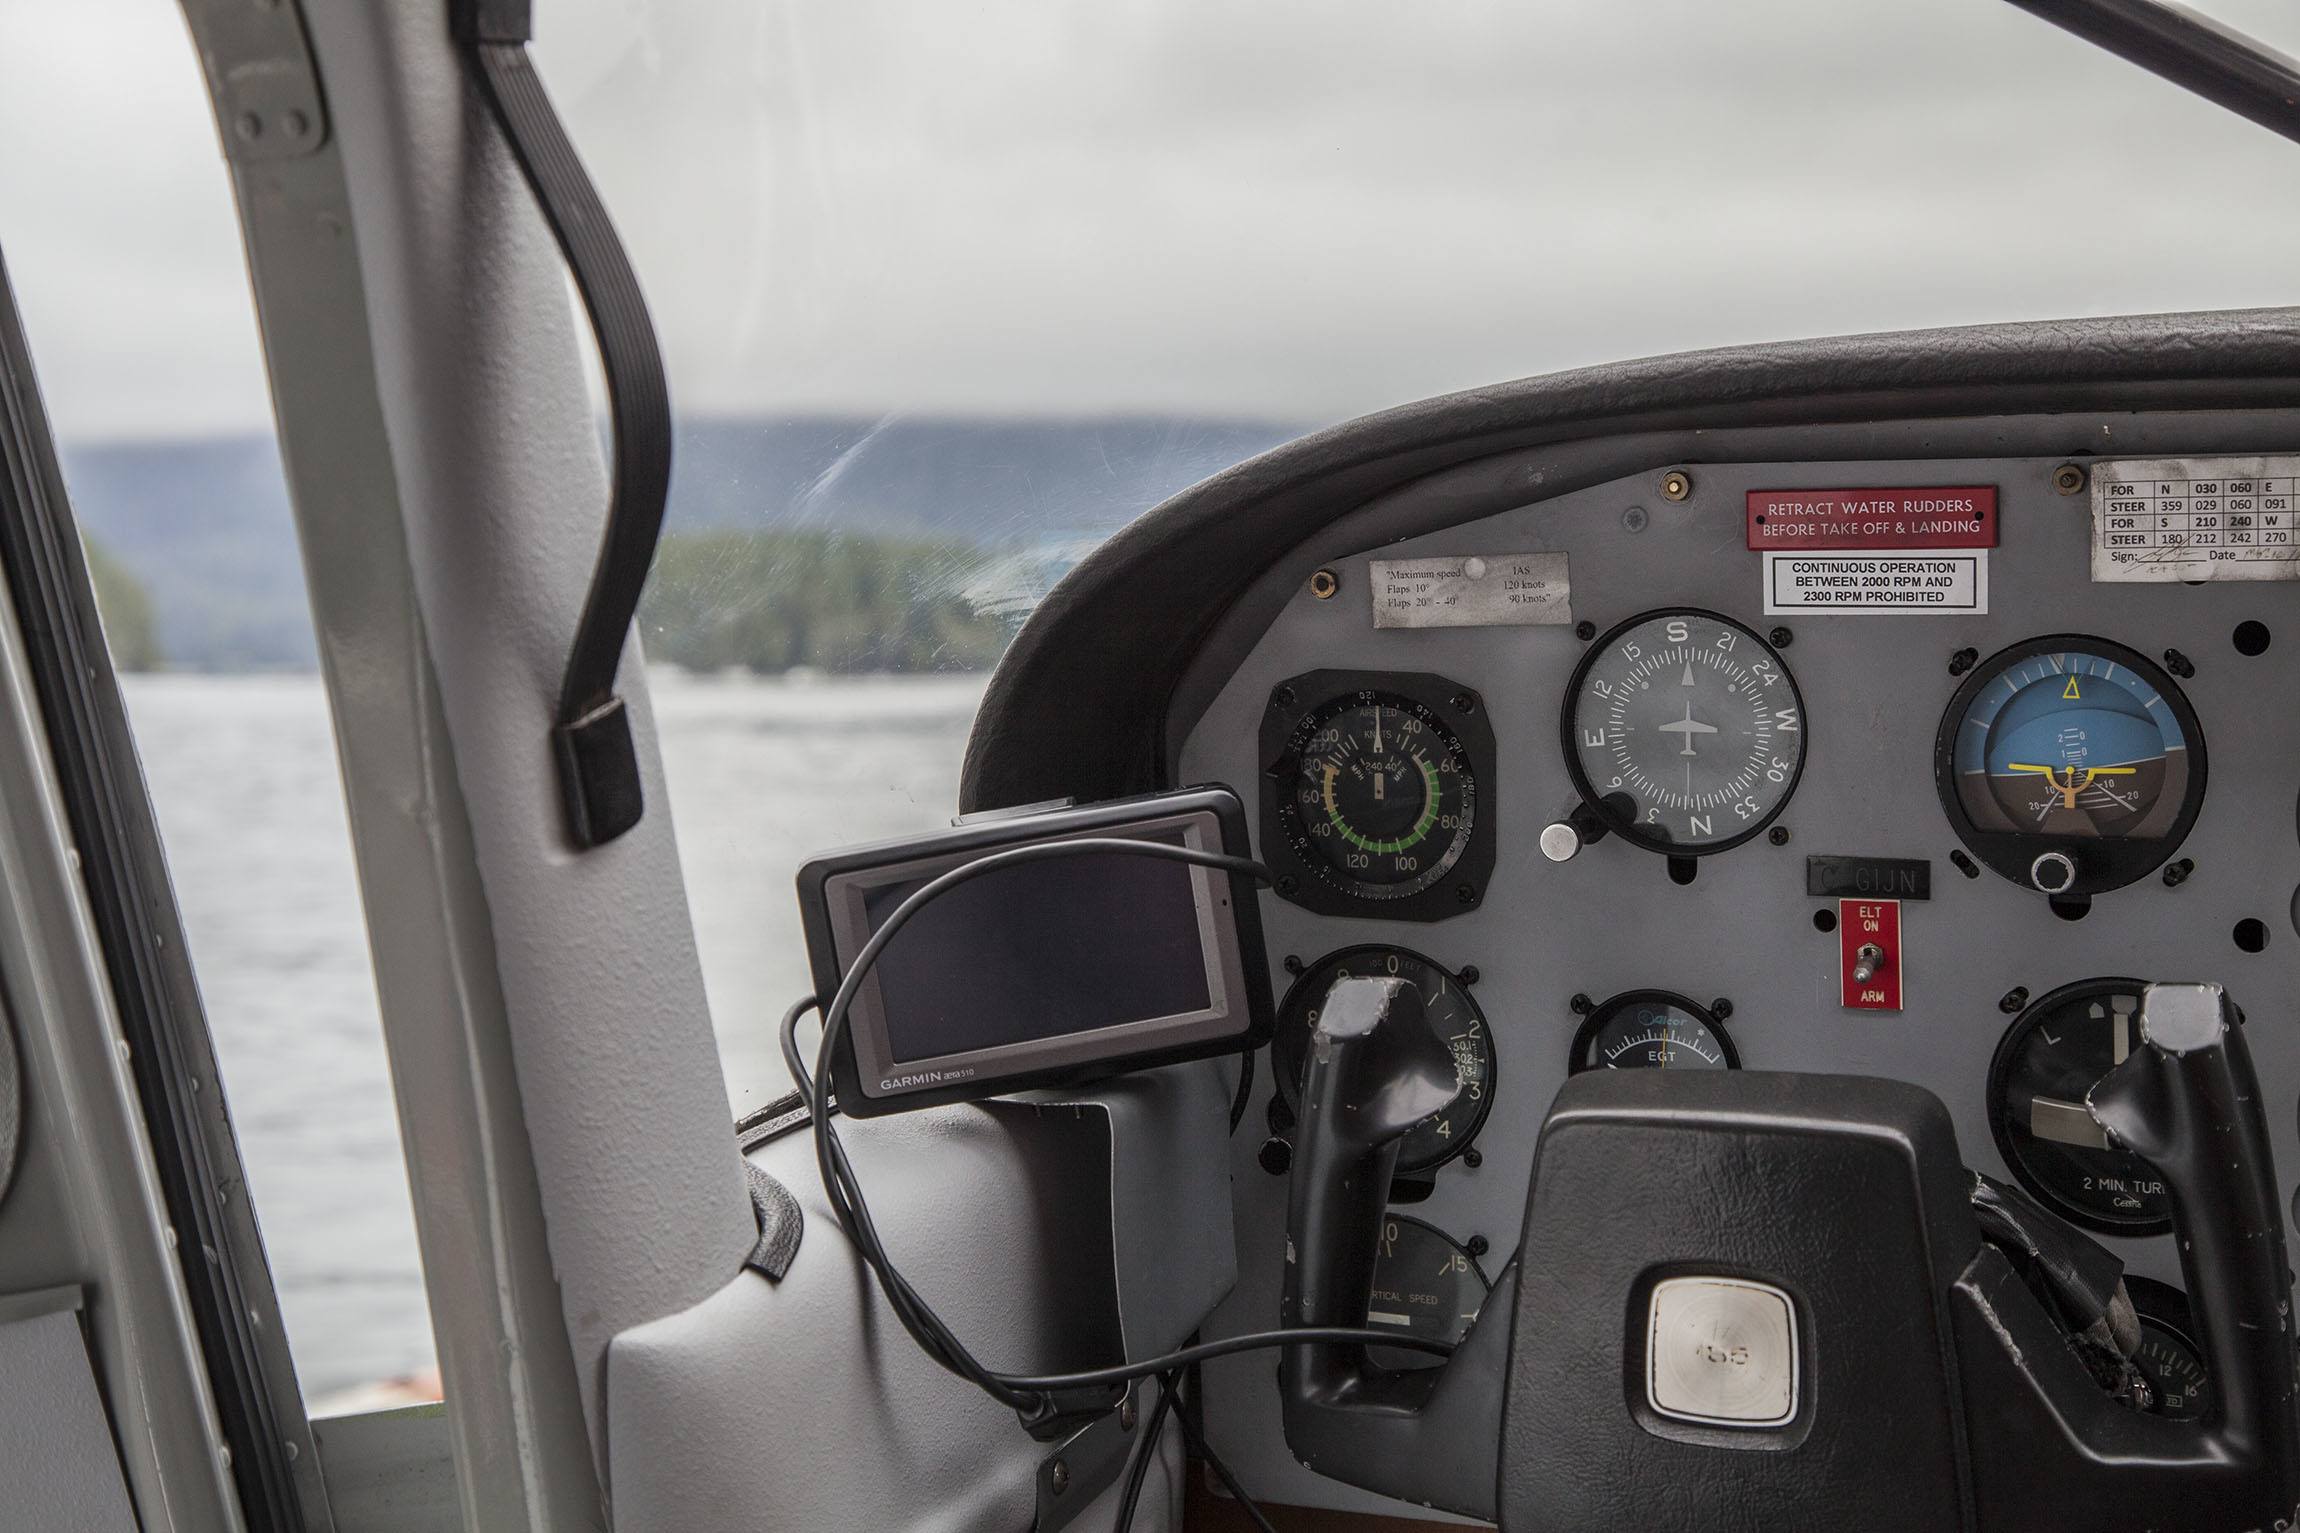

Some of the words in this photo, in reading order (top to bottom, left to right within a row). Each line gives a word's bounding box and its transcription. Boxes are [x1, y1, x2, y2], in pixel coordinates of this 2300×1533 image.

[2111, 485, 2134, 495] FOR
[2161, 484, 2170, 494] N
[2195, 483, 2217, 494] 030
[2230, 482, 2252, 492] 060
[2265, 482, 2272, 492] E
[1768, 503, 1834, 515] RETRACT
[1841, 501, 1897, 514] WATER
[1903, 499, 1973, 513] RUDDERS
[2111, 502, 2145, 512] STEER
[2161, 501, 2183, 511] 359
[2195, 500, 2217, 511] 029
[2230, 499, 2252, 510] 060
[2265, 498, 2287, 509] 091
[1763, 523, 1815, 536] BEFORE
[1820, 523, 1858, 535] TAKE
[1863, 522, 1890, 535] OFF
[1895, 522, 1905, 534] &
[1911, 520, 1981, 534] LANDING
[2111, 518, 2134, 528] FOR
[2161, 518, 2168, 528] S
[2195, 516, 2217, 527] 210
[2230, 516, 2252, 526] 240
[2265, 516, 2278, 526] W
[2111, 535, 2145, 545] STEER
[2161, 534, 2183, 545] 180
[2195, 533, 2217, 544] 212
[2230, 532, 2252, 543] 242
[2265, 532, 2287, 543] 270
[2111, 550, 2138, 563] Sign:
[2209, 550, 2236, 561] Date
[1436, 568, 1462, 580] speed
[1512, 566, 1531, 576] IAS
[1792, 562, 1876, 573] CONTINUOUS
[1879, 562, 1956, 573] OPERATION
[1503, 581, 1520, 590] 120
[1521, 580, 1546, 590] knots
[1796, 576, 1858, 587] BETWEEN
[1862, 576, 1890, 587] 2000
[1893, 576, 1921, 587] RPM
[1925, 576, 1953, 587] AND
[1387, 585, 1411, 595] Flaps
[1804, 591, 1832, 602] 2300
[1835, 591, 1862, 602] RPM
[1866, 591, 1944, 602] PROHIBITED
[1387, 598, 1411, 609] Flaps
[1509, 595, 1521, 604] 90
[1666, 621, 1689, 643] S
[1716, 631, 1737, 652] 21
[1621, 641, 1642, 662] 15
[1752, 659, 1779, 687] 24
[1592, 679, 1613, 699] 12
[1402, 719, 1422, 734] 40
[1775, 707, 1799, 731] W
[1584, 727, 1606, 747] E
[1350, 764, 1365, 782] MPH
[1364, 762, 1382, 771] 240
[1384, 762, 1397, 771] 40
[1440, 758, 1458, 773] 60
[1767, 756, 1789, 783] 30
[1394, 766, 1408, 782] MPH
[2045, 786, 2056, 795] 10
[2103, 779, 2115, 789] 10
[2126, 790, 2139, 800] 20
[1734, 795, 1761, 820] 33
[2028, 801, 2040, 811] 20
[1440, 815, 1460, 829] 80
[1646, 807, 1660, 825] 3
[1308, 822, 1331, 837] 140
[1690, 815, 1713, 836] N
[1347, 854, 1369, 869] 120
[1395, 856, 1418, 871] 100
[1855, 867, 1916, 893] GIJN
[1859, 906, 1883, 919] ELT
[1863, 919, 1879, 932] ON
[1387, 954, 1399, 974] 0
[1861, 990, 1885, 1003] ARM
[1468, 1019, 1481, 1039] 2
[1648, 1050, 1676, 1062] EGT
[880, 1071, 942, 1090] GARMIN
[1469, 1082, 1481, 1100] 3
[1436, 1120, 1451, 1139] 4
[2083, 1176, 2092, 1190] 2
[2132, 1180, 2166, 1195] TUR
[1381, 1223, 1399, 1242] 10
[1451, 1254, 1468, 1273] 15
[1372, 1290, 1402, 1301] RTICAL
[1408, 1294, 1439, 1305] SPEED
[2159, 1364, 2173, 1377] 12
[2184, 1384, 2199, 1398] 16
